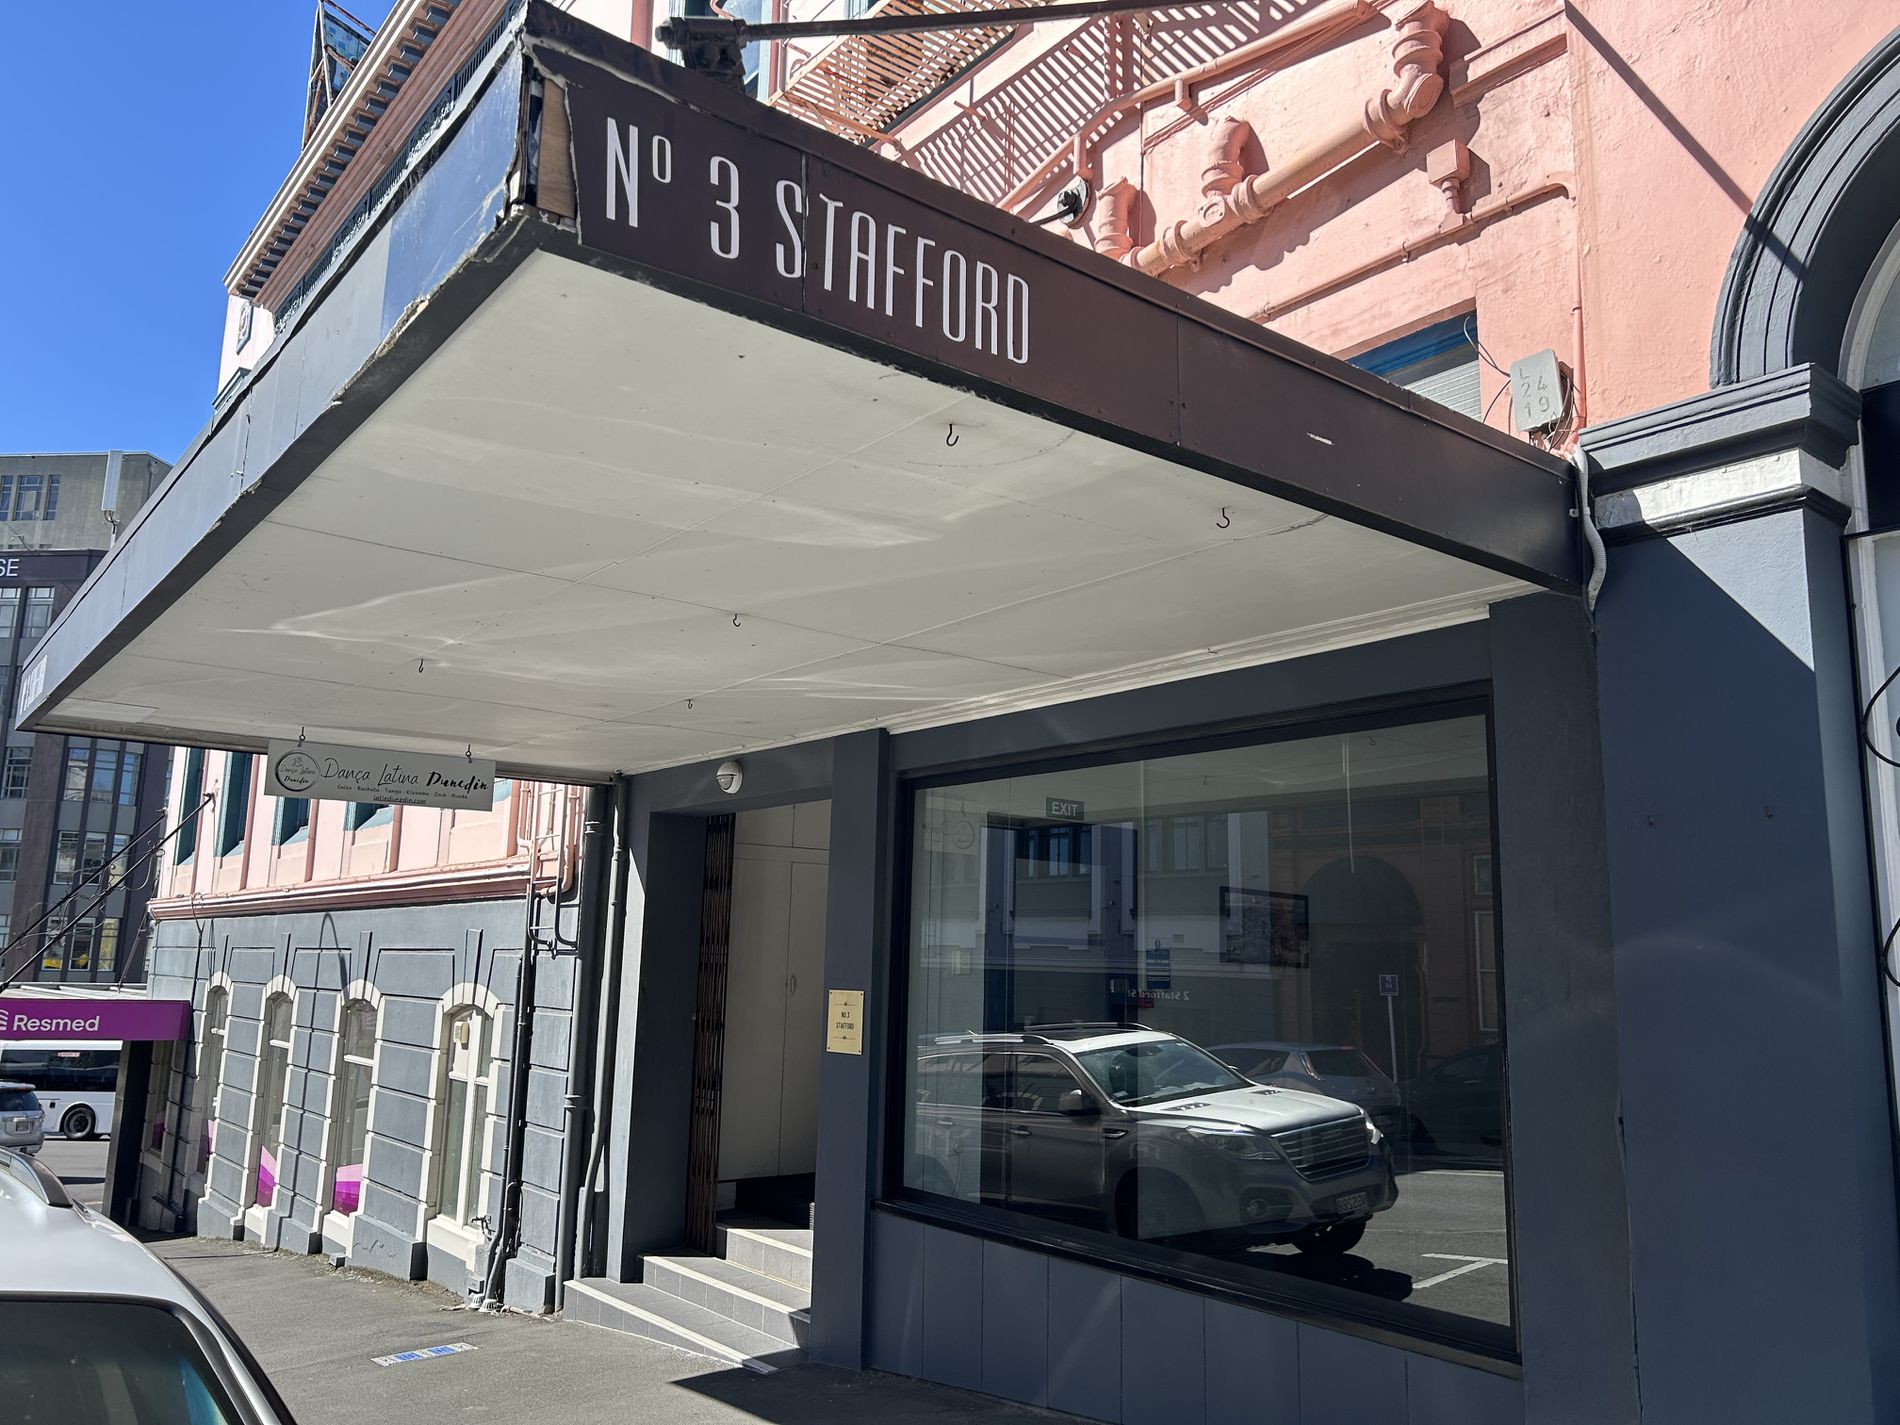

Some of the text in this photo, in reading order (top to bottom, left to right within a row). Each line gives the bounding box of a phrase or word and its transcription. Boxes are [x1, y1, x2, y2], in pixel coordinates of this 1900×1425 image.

[709, 155, 740, 260] 3
[775, 178, 1031, 365] STAFFORD
[320, 757, 488, 795] Dança Latina Dunedin
[1052, 801, 1078, 817] EXIT
[13, 1014, 100, 1032] Resmed
